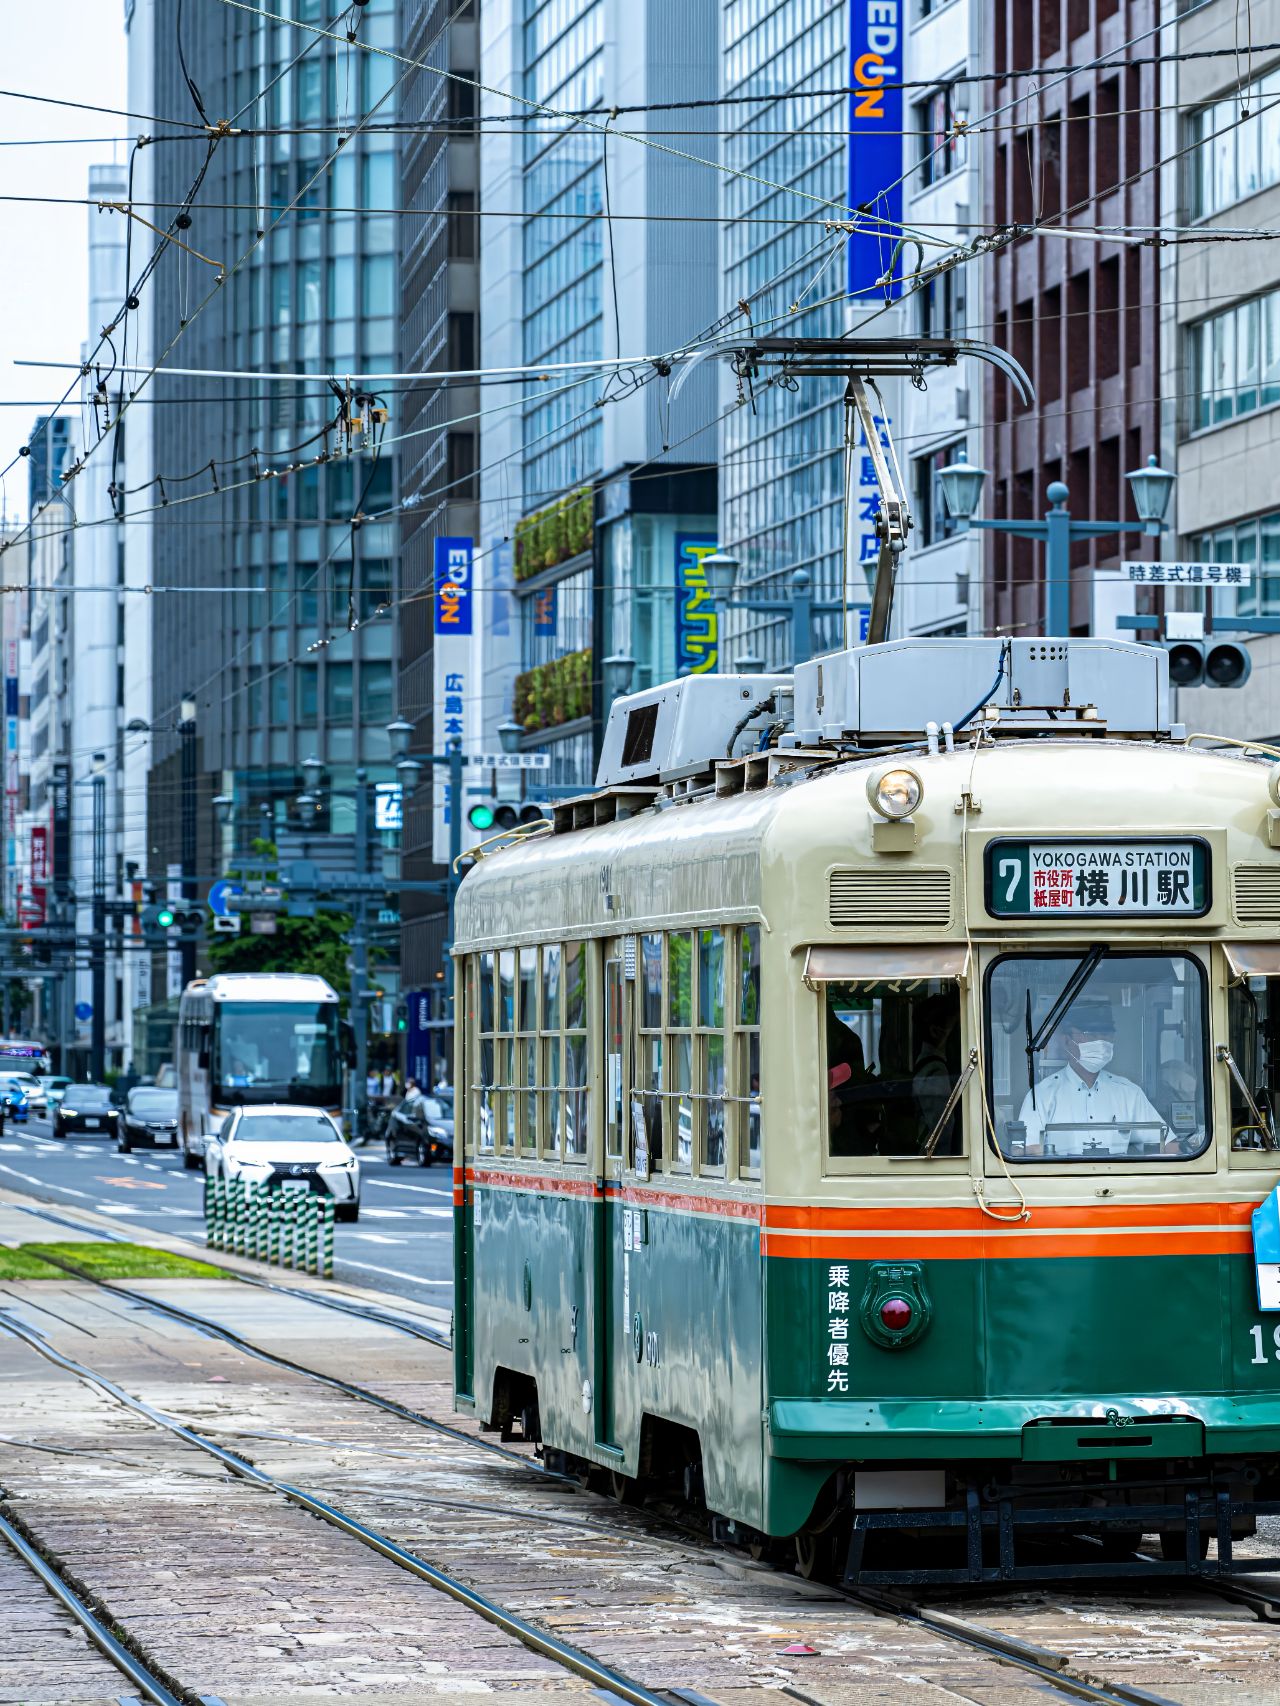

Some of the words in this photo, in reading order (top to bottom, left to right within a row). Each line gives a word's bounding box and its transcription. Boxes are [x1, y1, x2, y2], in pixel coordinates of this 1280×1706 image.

[854, 1, 897, 118] EDION
[440, 549, 467, 624] EDION
[1129, 565, 1242, 583] 時差式信号機
[1033, 852, 1122, 867] YOKOGAWA
[1125, 852, 1190, 867] STATION
[1034, 869, 1074, 888] 市役所
[999, 859, 1022, 902] 7
[1033, 889, 1074, 908] 紙屋町
[1075, 869, 1190, 907] 横川駅
[827, 1265, 850, 1393] 乗降者優先
